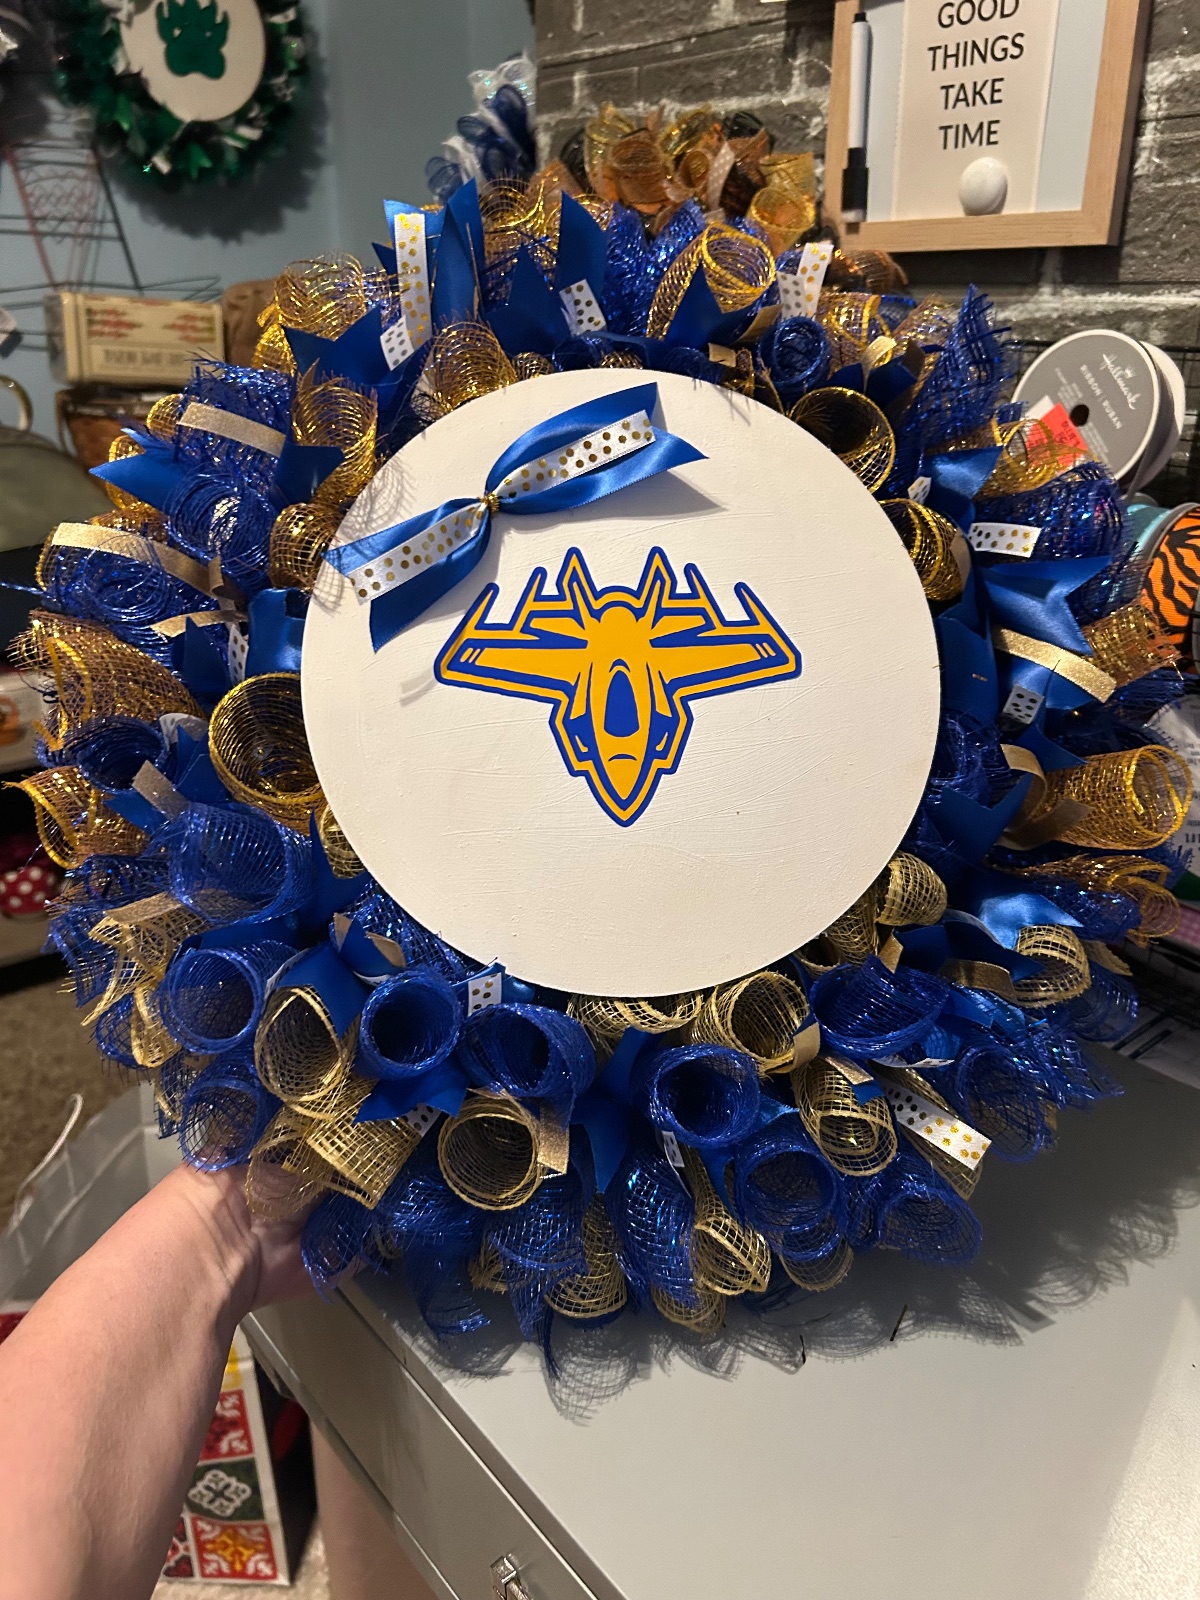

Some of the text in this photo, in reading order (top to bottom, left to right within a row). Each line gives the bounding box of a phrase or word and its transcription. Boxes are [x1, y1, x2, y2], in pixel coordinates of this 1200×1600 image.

[937, 0, 1020, 29] GOOD
[927, 32, 1025, 72] THINGS
[940, 77, 1004, 110] TAKE
[938, 119, 1001, 150] TIME
[1080, 364, 1103, 396] RIBBON
[1102, 399, 1122, 429] RUBAN
[1100, 353, 1141, 410] Hallmark
